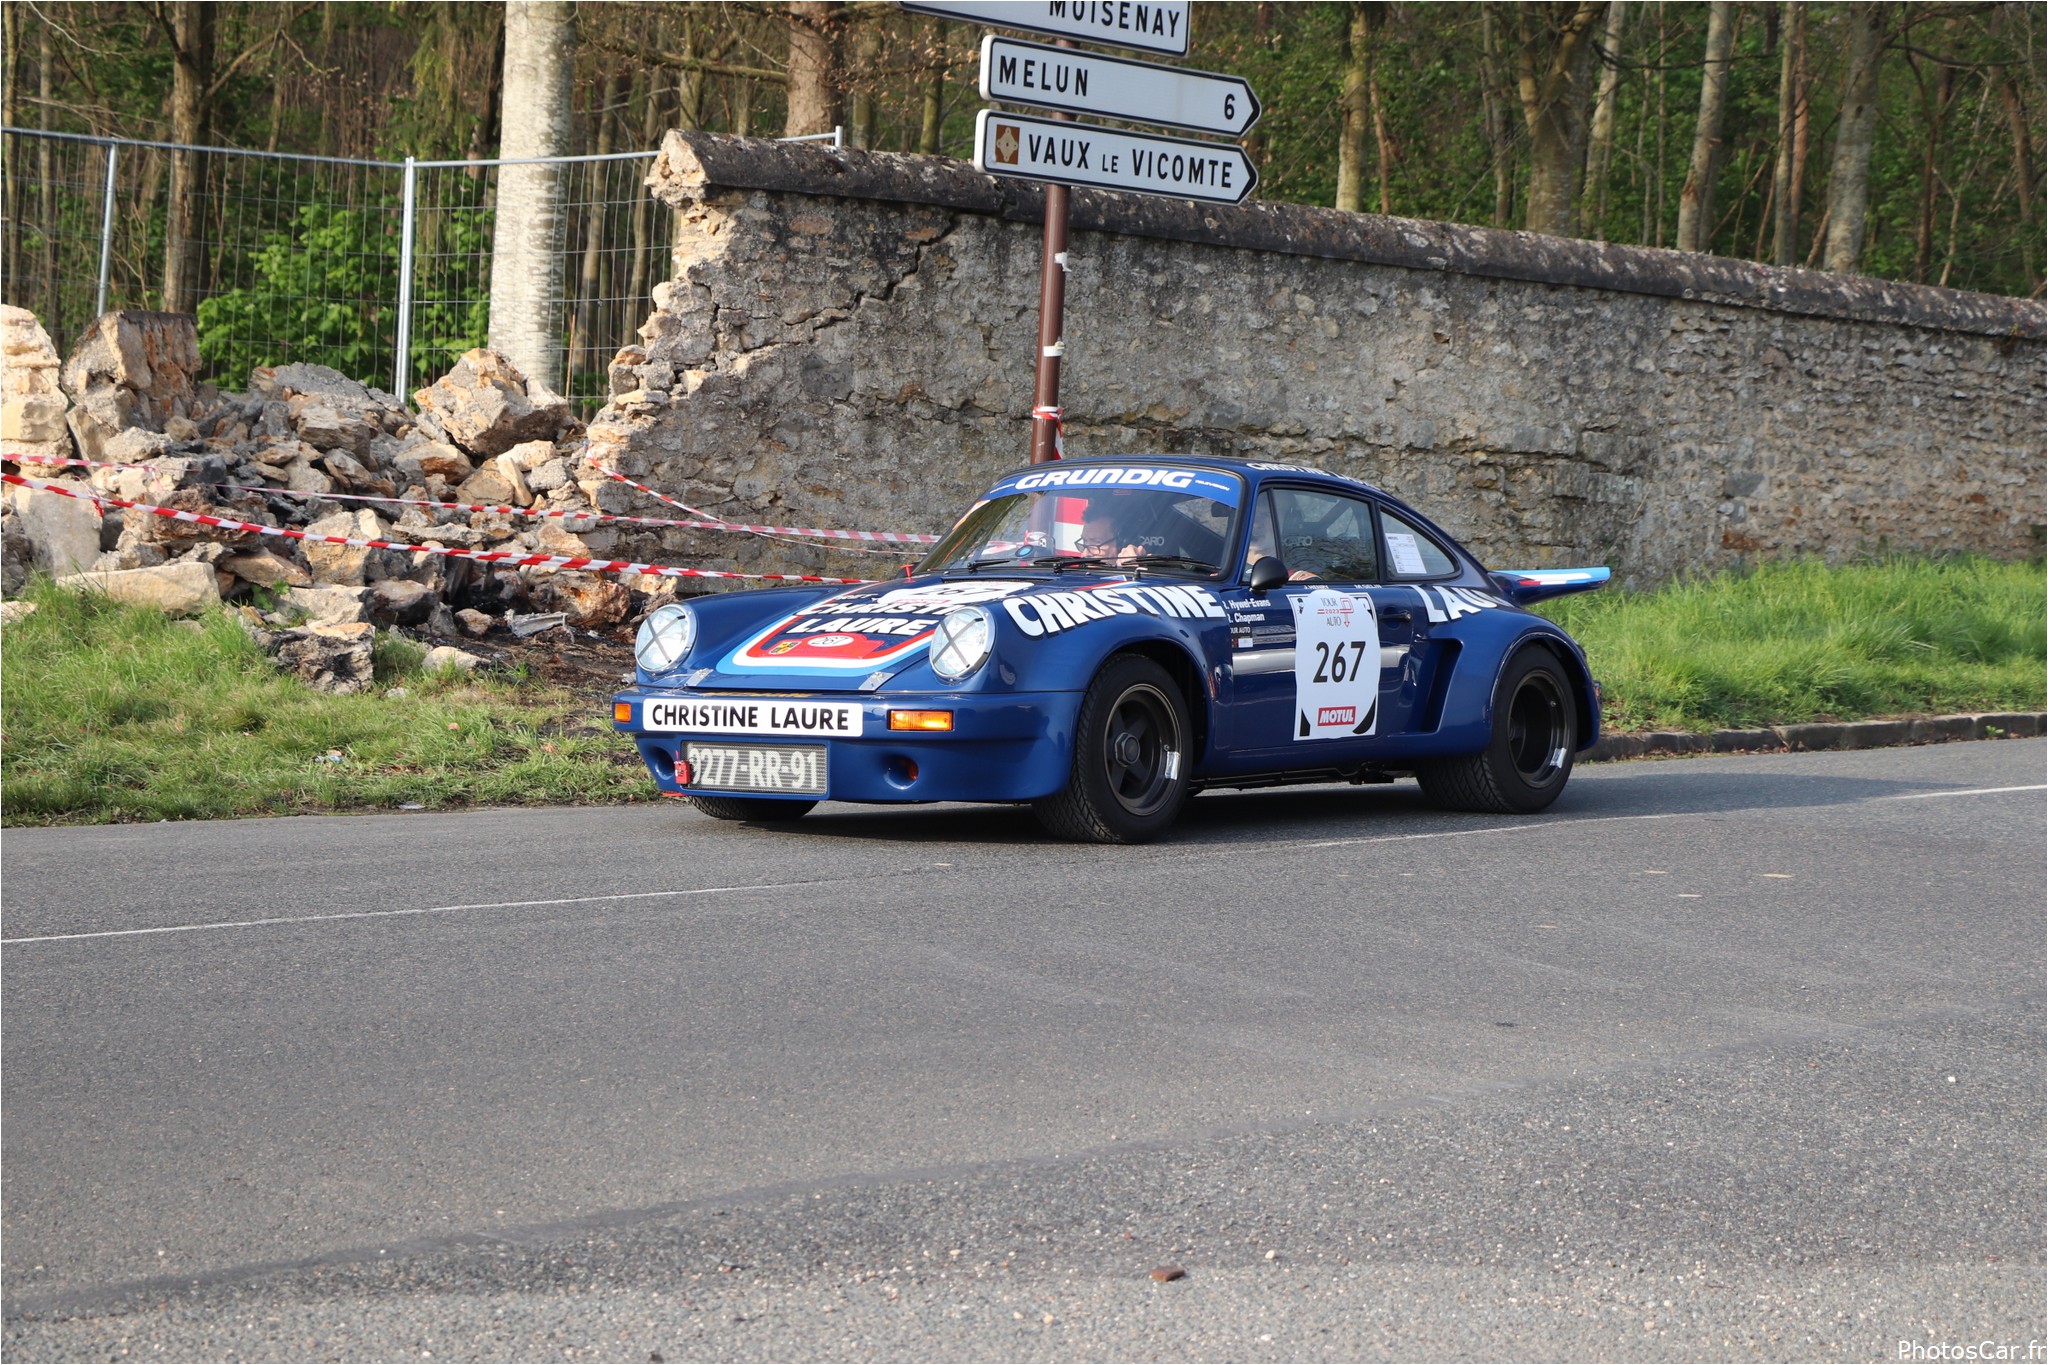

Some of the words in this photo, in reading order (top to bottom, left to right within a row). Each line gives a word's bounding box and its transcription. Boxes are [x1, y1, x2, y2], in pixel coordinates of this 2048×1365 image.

[1049, 1, 1180, 38] MOISENAY
[999, 55, 1088, 97] MELUN
[1223, 93, 1236, 120] 6
[1028, 134, 1091, 170] VAUX
[1102, 153, 1119, 173] LE
[1132, 149, 1233, 188] VICOMTE
[1015, 468, 1196, 490] GRUNDIG
[797, 601, 969, 616] CHRISTI
[1002, 585, 1227, 636] CHRISTINE
[1320, 598, 1338, 607] TOUR
[1410, 584, 1514, 623] LAU
[786, 617, 939, 636] LAURE
[1234, 612, 1265, 624] Chapman
[1327, 617, 1342, 627] AUTO
[1313, 641, 1366, 683] 267
[652, 704, 758, 727] CHRISTINE
[771, 707, 849, 730] LAURE
[1319, 710, 1354, 723] MOTUL
[689, 748, 818, 789] 9277-RR-91
